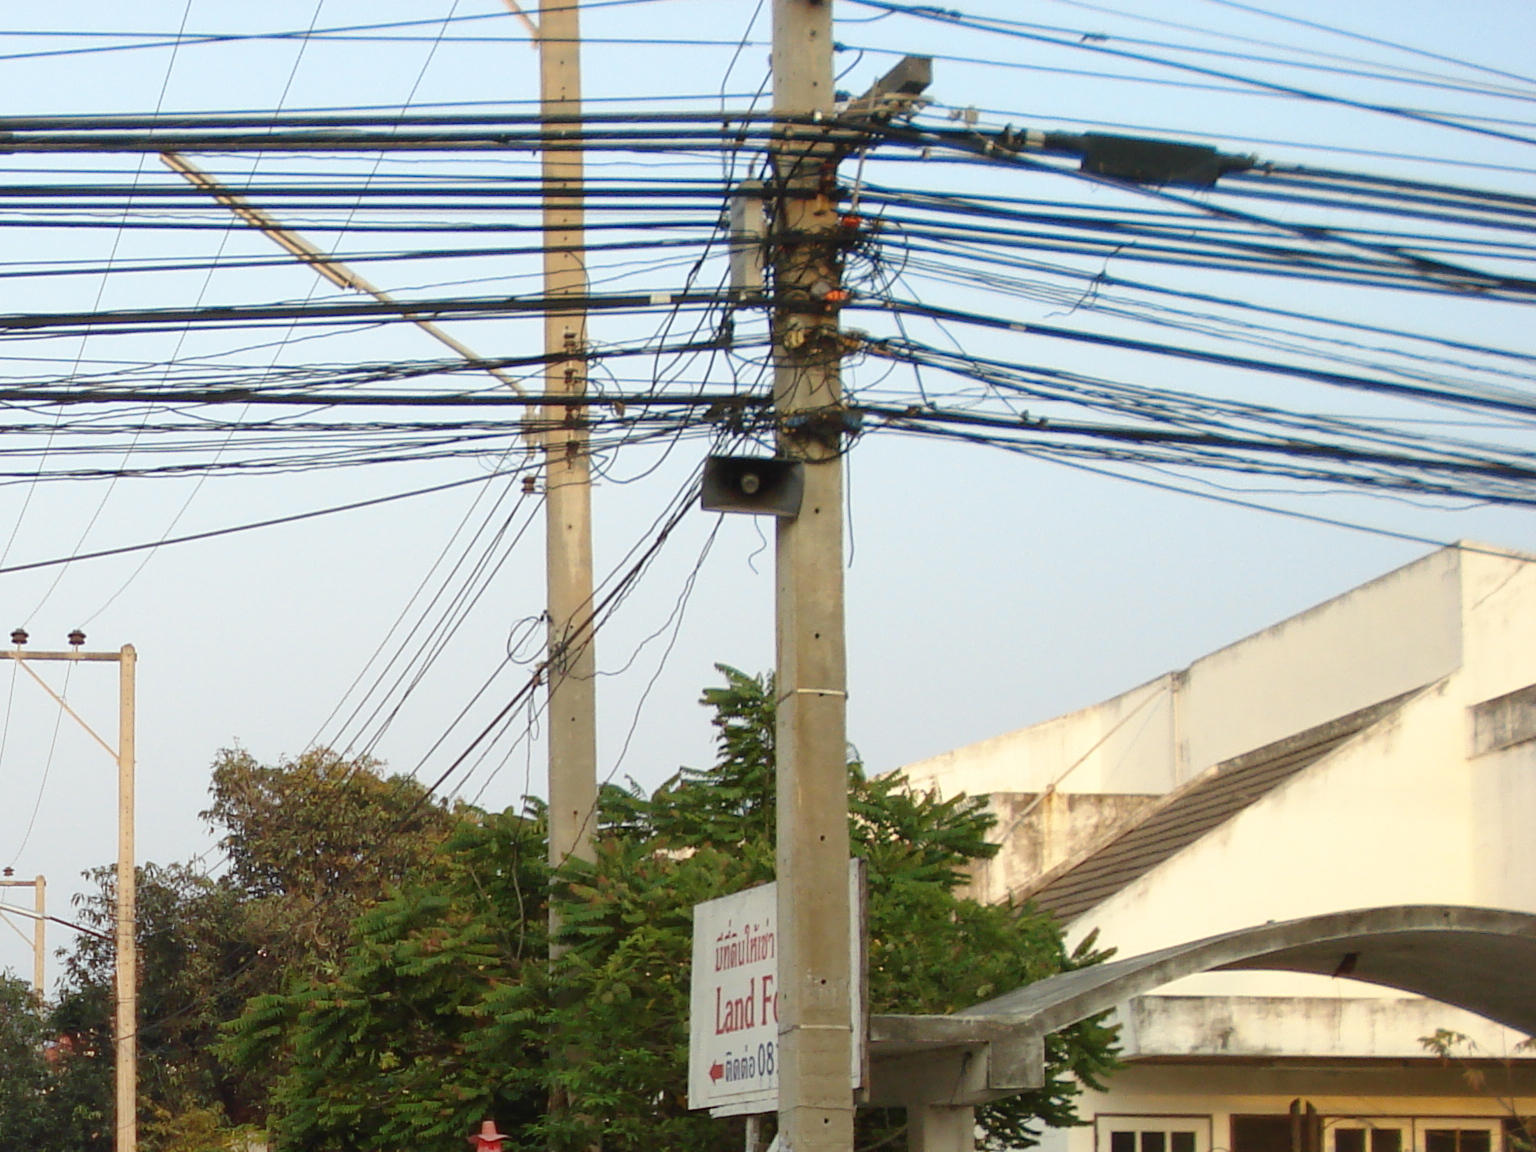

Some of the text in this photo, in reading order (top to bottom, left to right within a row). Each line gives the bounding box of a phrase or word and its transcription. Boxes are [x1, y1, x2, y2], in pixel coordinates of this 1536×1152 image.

[715, 977, 755, 1036] Land
[725, 1041, 779, 1083] ติดต่อ 08
